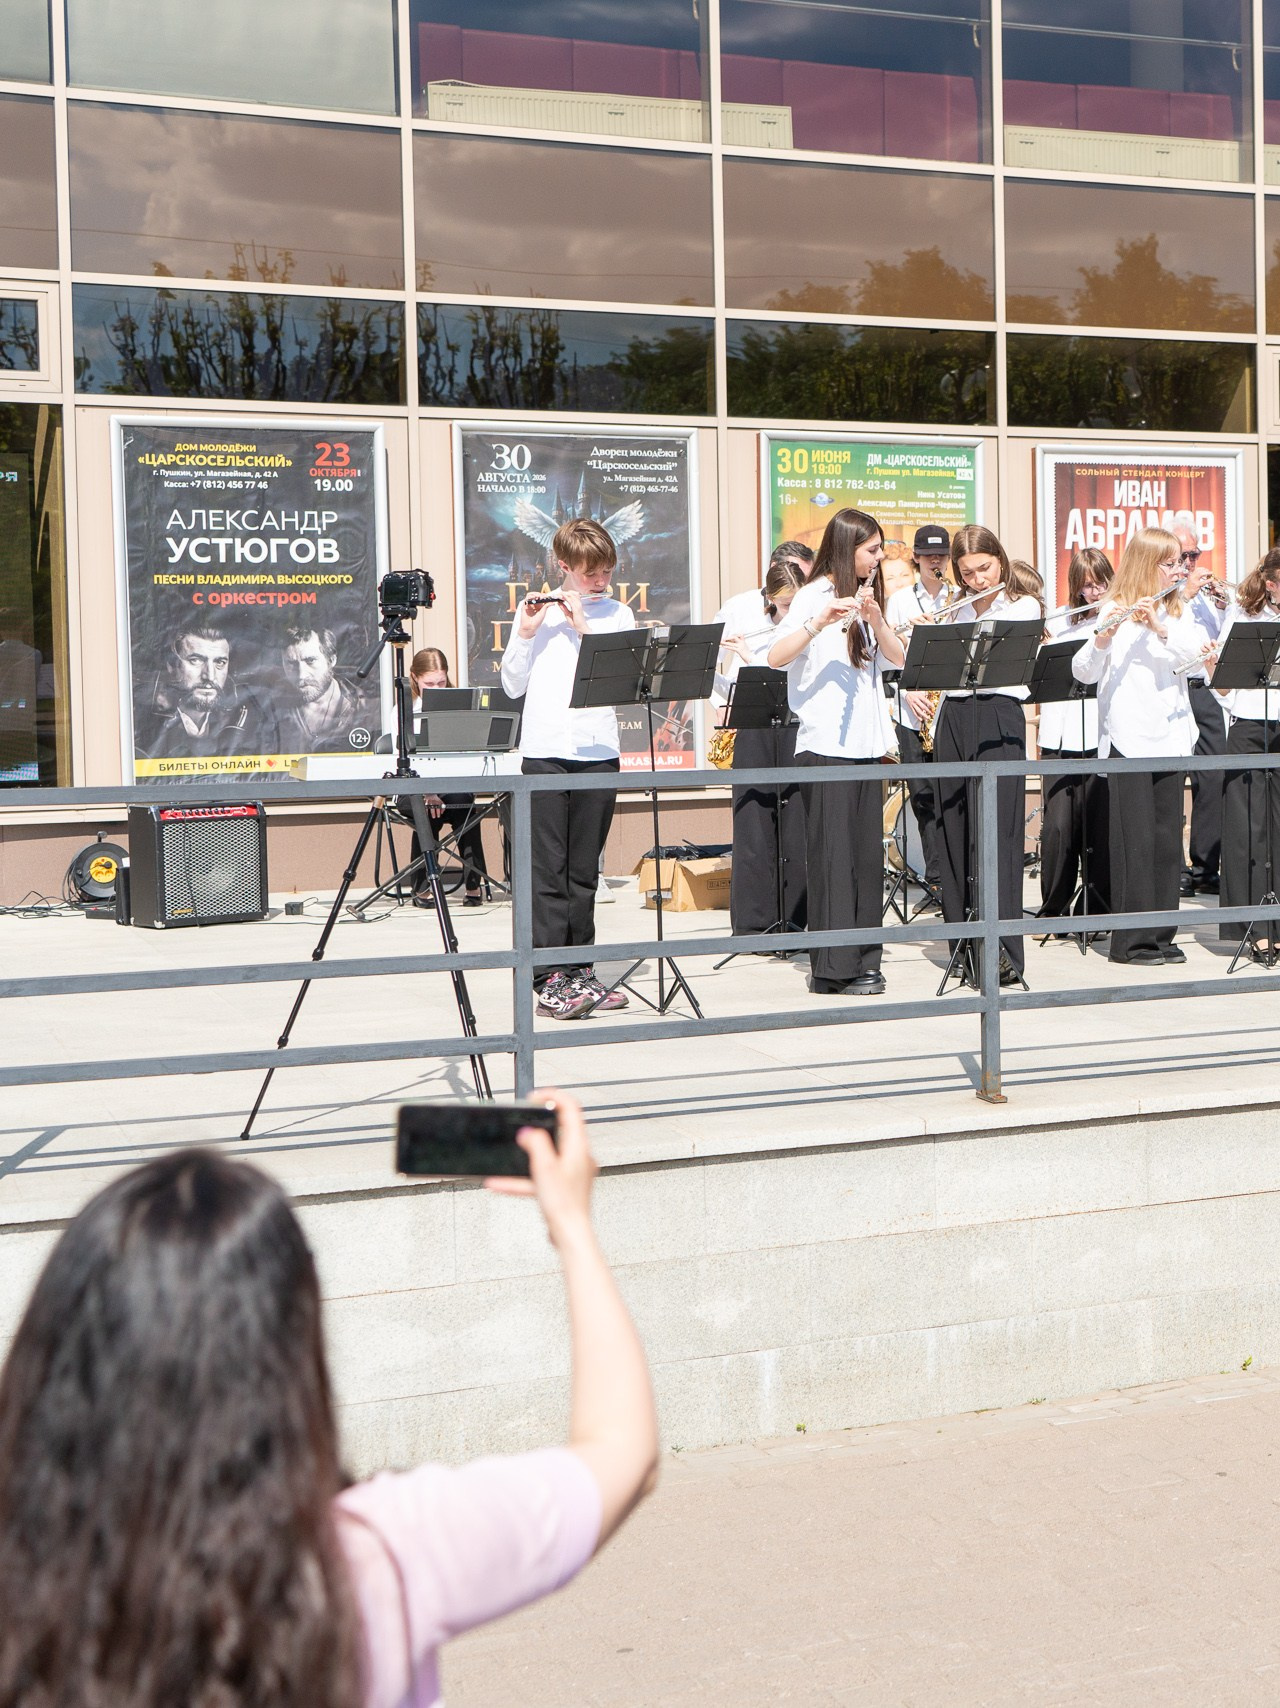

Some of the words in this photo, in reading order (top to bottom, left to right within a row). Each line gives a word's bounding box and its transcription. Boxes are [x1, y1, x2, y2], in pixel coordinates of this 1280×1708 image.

[175, 443, 198, 452] ДОМ
[199, 443, 257, 453] МОЛОДЁЖИ
[315, 442, 351, 467] 23
[590, 446, 628, 459] Дворец
[629, 448, 678, 458] молодёжи
[138, 453, 293, 468] «ЦАРСКОСЕЛЬСКИЙ»
[490, 443, 532, 471] 30
[777, 447, 809, 474] 30
[811, 449, 851, 463] ИЮНЯ
[867, 453, 882, 466] ДМ
[884, 454, 972, 467] «ЦАРСКОСЕЛЬСКИЙ»
[160, 469, 193, 478] Пушкин,
[207, 469, 254, 479] Магазейная,
[309, 467, 357, 477] ОКТЯБРЯ
[811, 463, 842, 475] 19:00
[873, 467, 900, 476] Пушкин
[1075, 468, 1120, 477] СОЛЬНЫЙ
[1122, 469, 1163, 478] СТЕНДАП
[1165, 470, 1205, 479] КОНЦЕРТ
[476, 472, 531, 483] АВГУСТА
[777, 477, 807, 488] Касса
[815, 478, 822, 488] 8
[824, 479, 843, 489] 812
[845, 479, 896, 490] 762-03-64
[164, 480, 189, 488] Касса:
[190, 480, 201, 488] +7
[203, 480, 225, 489] (812)
[227, 481, 243, 489] 456
[244, 481, 256, 489] 77
[257, 481, 268, 489] 46
[314, 478, 354, 491] 19.00
[477, 484, 517, 493] НАЧАЛО
[519, 485, 525, 493] В
[527, 485, 546, 494] 18:00
[619, 485, 628, 493] +7
[629, 485, 646, 494] (812)
[778, 493, 798, 505] 16+
[1113, 480, 1166, 508] ИВАН
[166, 509, 338, 535] АЛЕКСАНДР
[1065, 508, 1215, 551] АБРАВ
[166, 537, 341, 564] УСТЮГОВ
[153, 574, 195, 585] ПЕСНИ
[197, 575, 275, 586] ВЛАДИМИРА
[277, 575, 353, 586] ВЫСОЦКОГО
[192, 594, 204, 605] с
[208, 591, 317, 608] оркестром
[351, 732, 369, 744] 12+
[159, 762, 208, 772] БИЛЕТЫ
[211, 758, 261, 770] ОНЛАЙН
[620, 755, 683, 766] NKASA.RU
